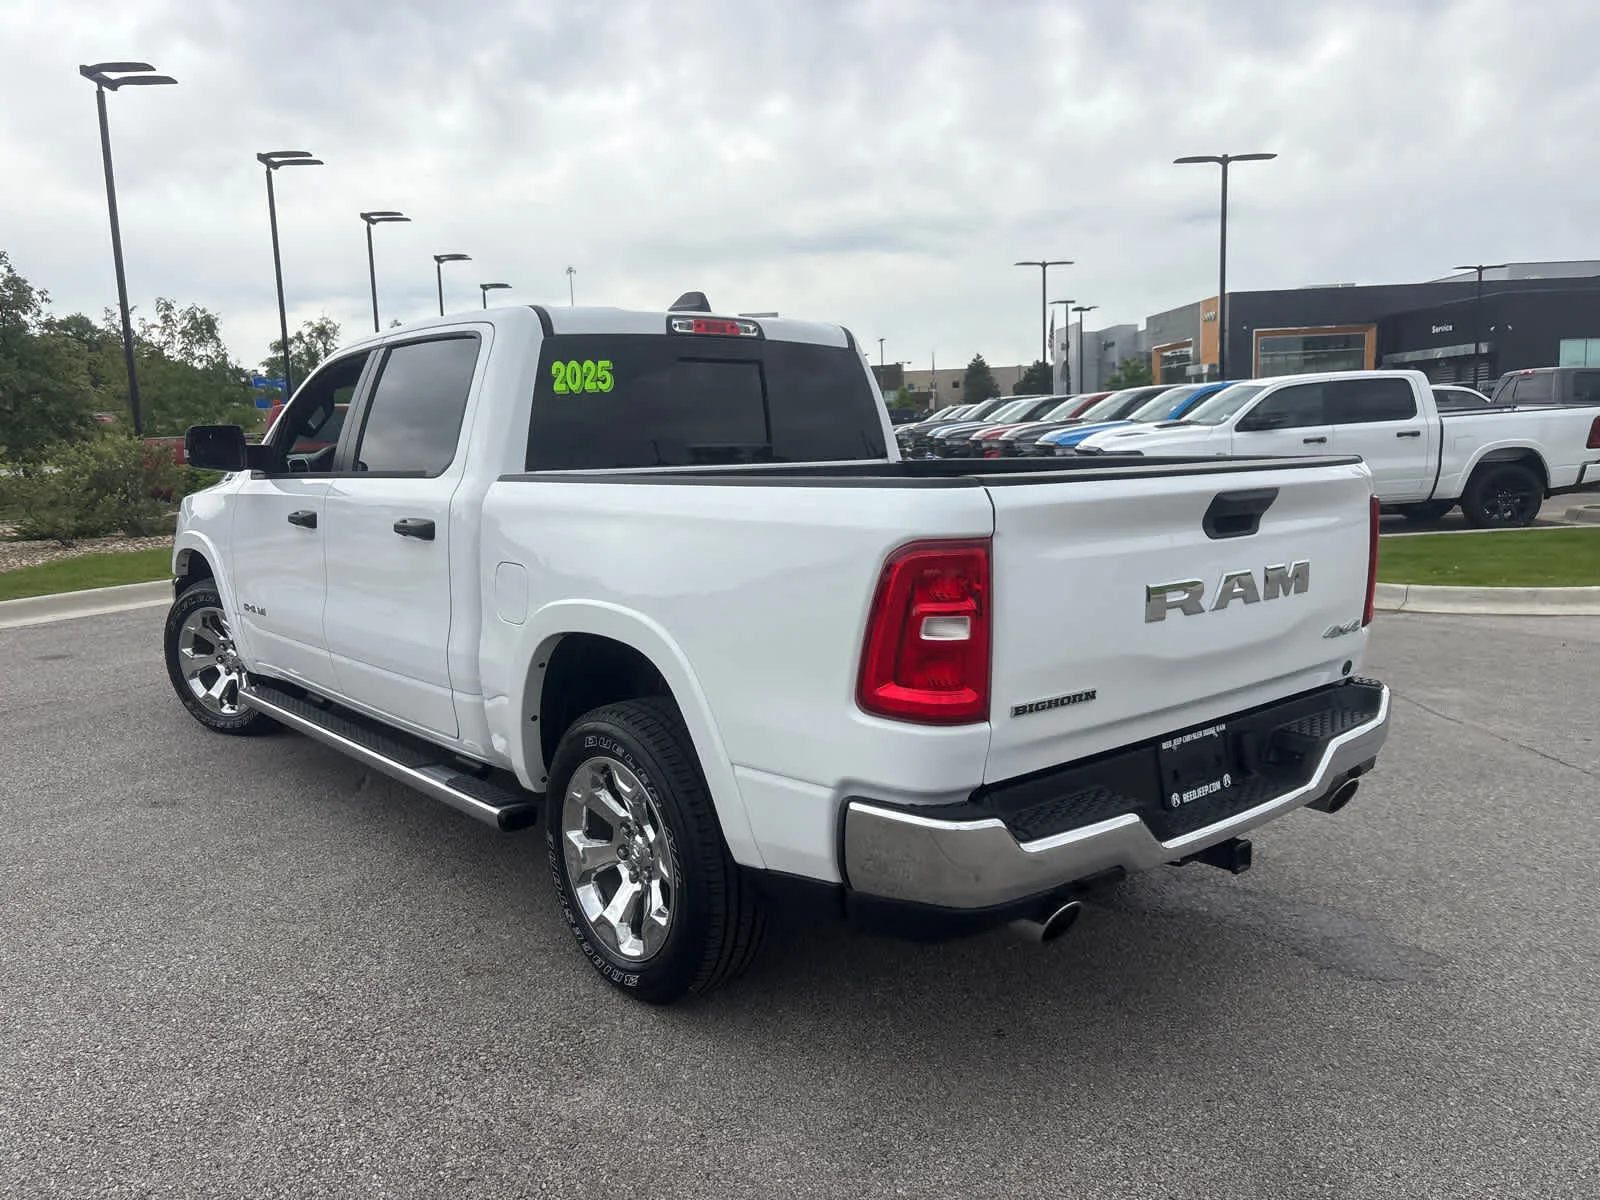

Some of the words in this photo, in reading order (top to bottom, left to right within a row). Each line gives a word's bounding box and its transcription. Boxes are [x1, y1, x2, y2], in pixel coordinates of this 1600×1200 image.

[1431, 325, 1453, 334] Service
[551, 360, 615, 394] 2025
[1145, 559, 1310, 623] RAM
[1010, 689, 1097, 718] BIGHORN
